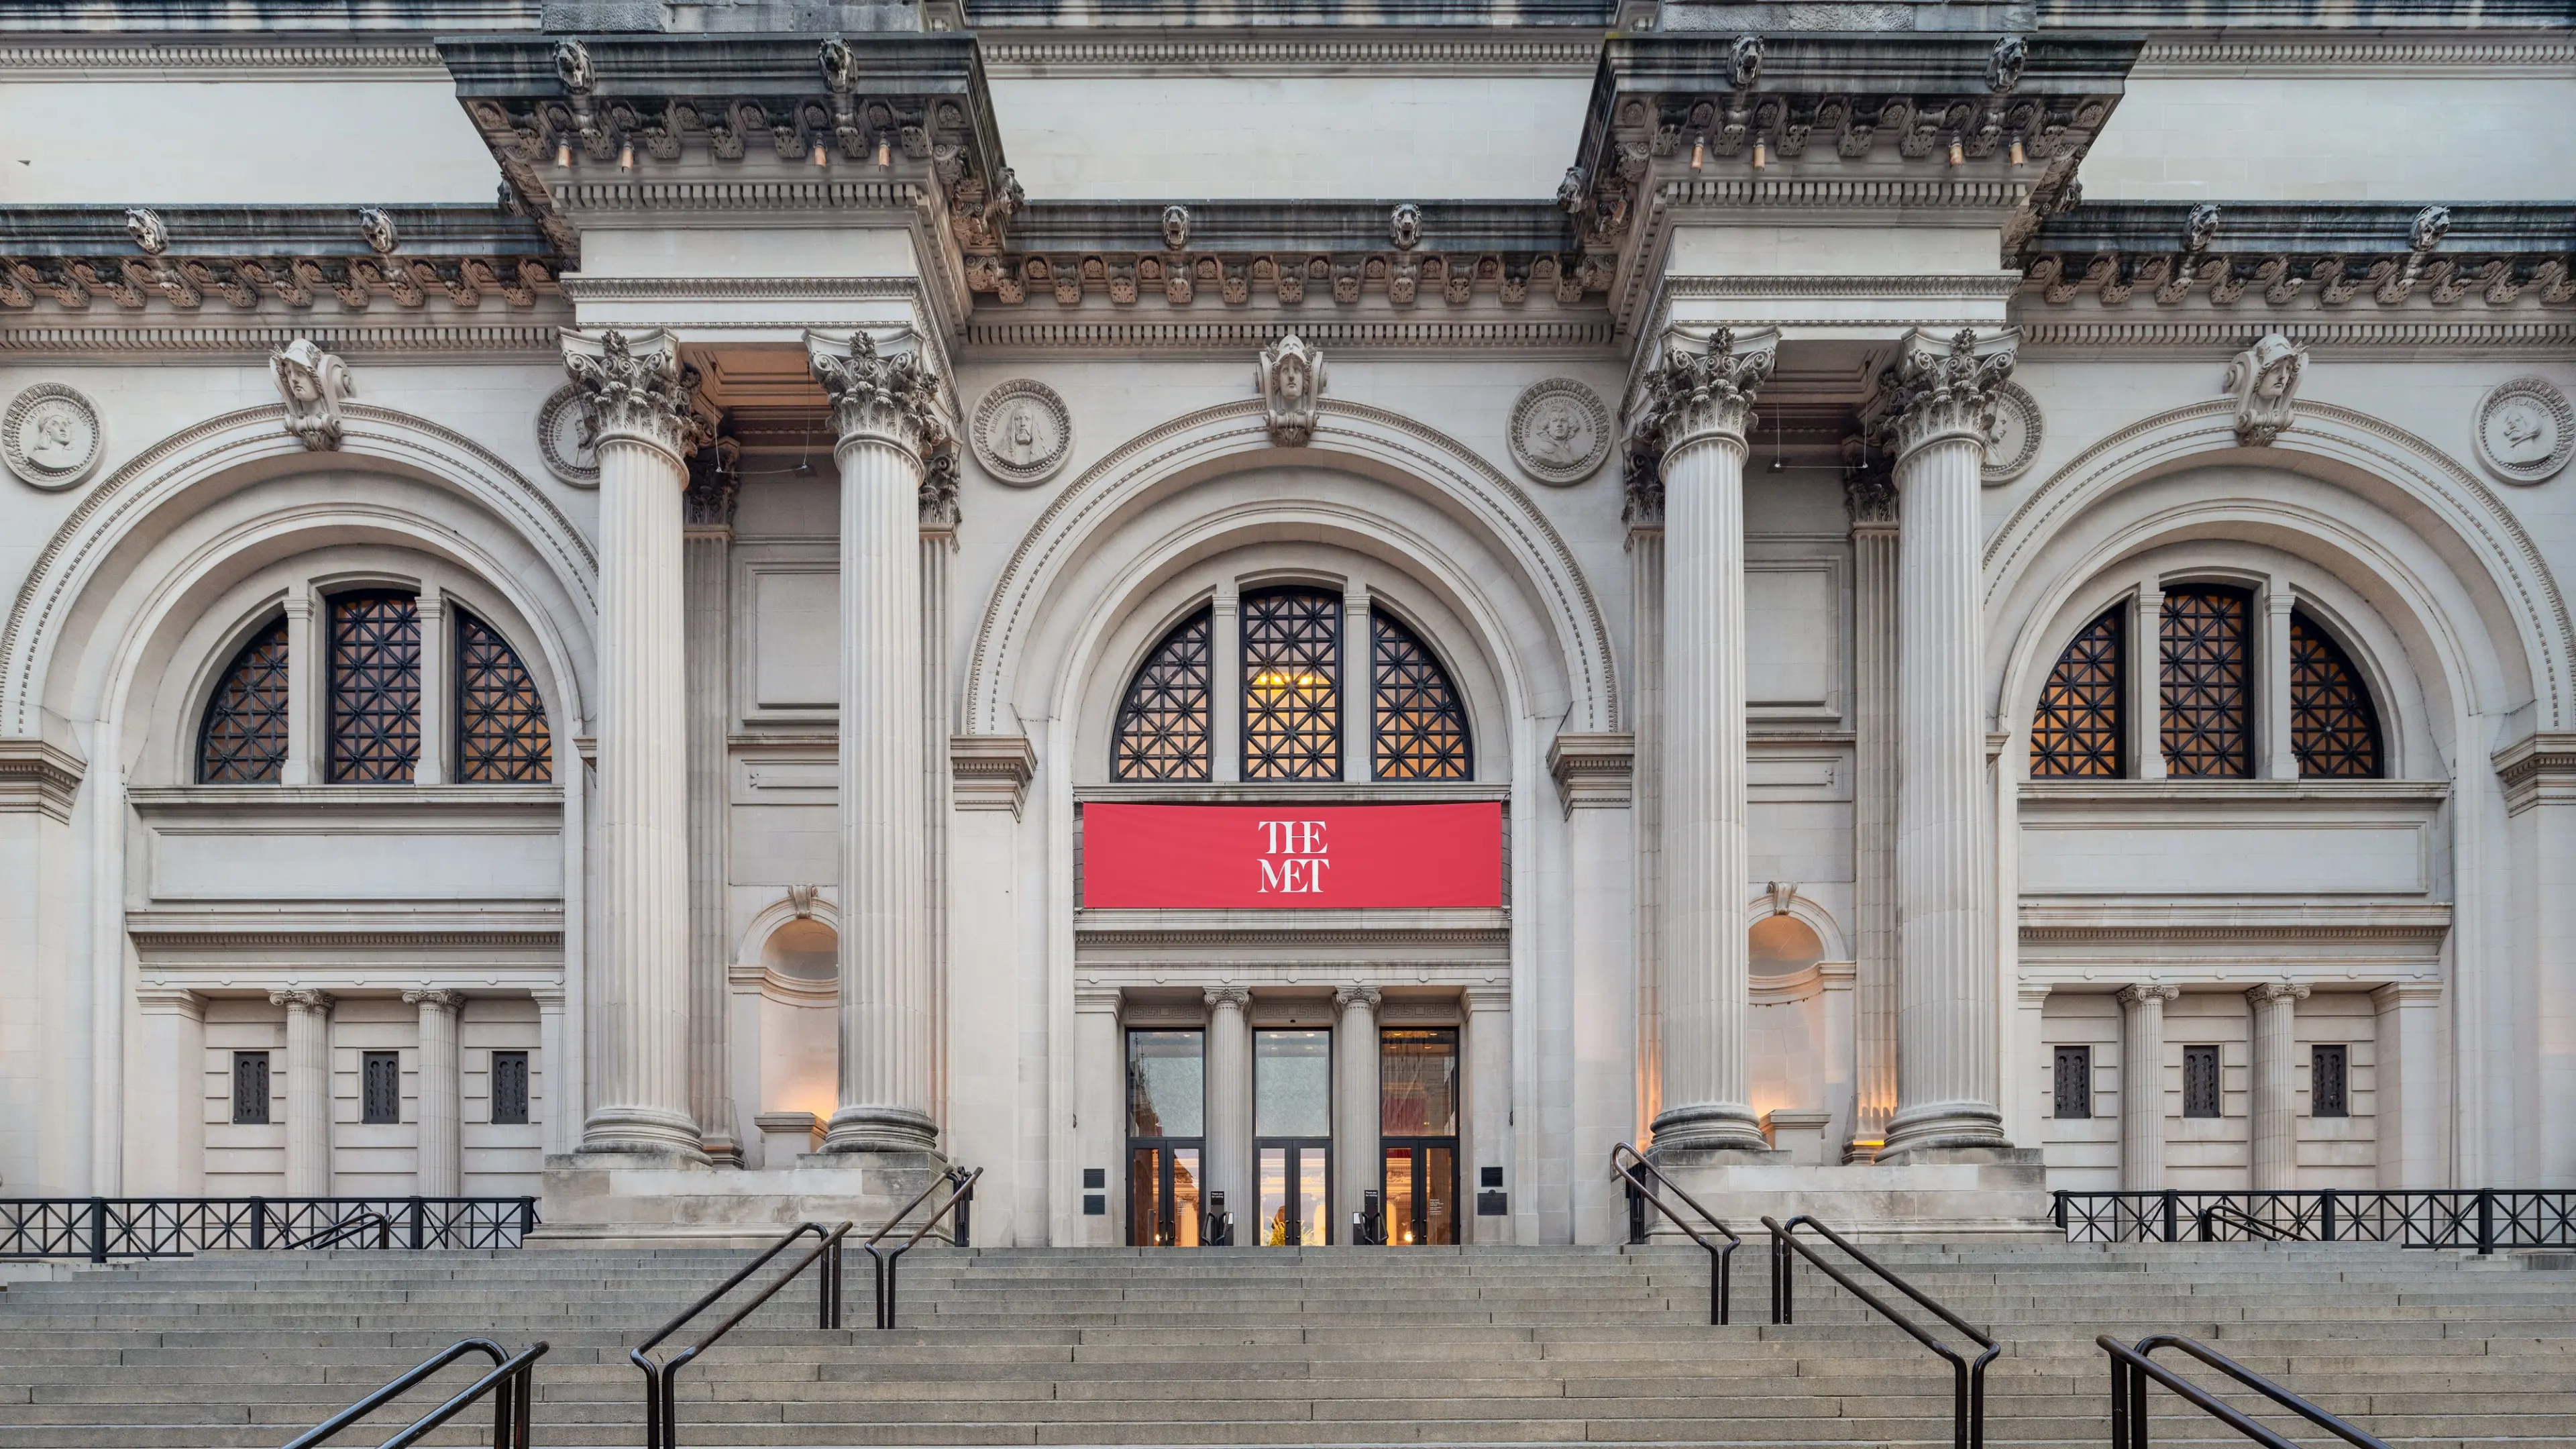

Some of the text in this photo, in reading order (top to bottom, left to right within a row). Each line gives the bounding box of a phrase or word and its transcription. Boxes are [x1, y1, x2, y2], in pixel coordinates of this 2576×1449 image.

[555, 402, 582, 441] MICHAELAN
[1258, 821, 1328, 854] THE
[1256, 859, 1330, 893] MET
